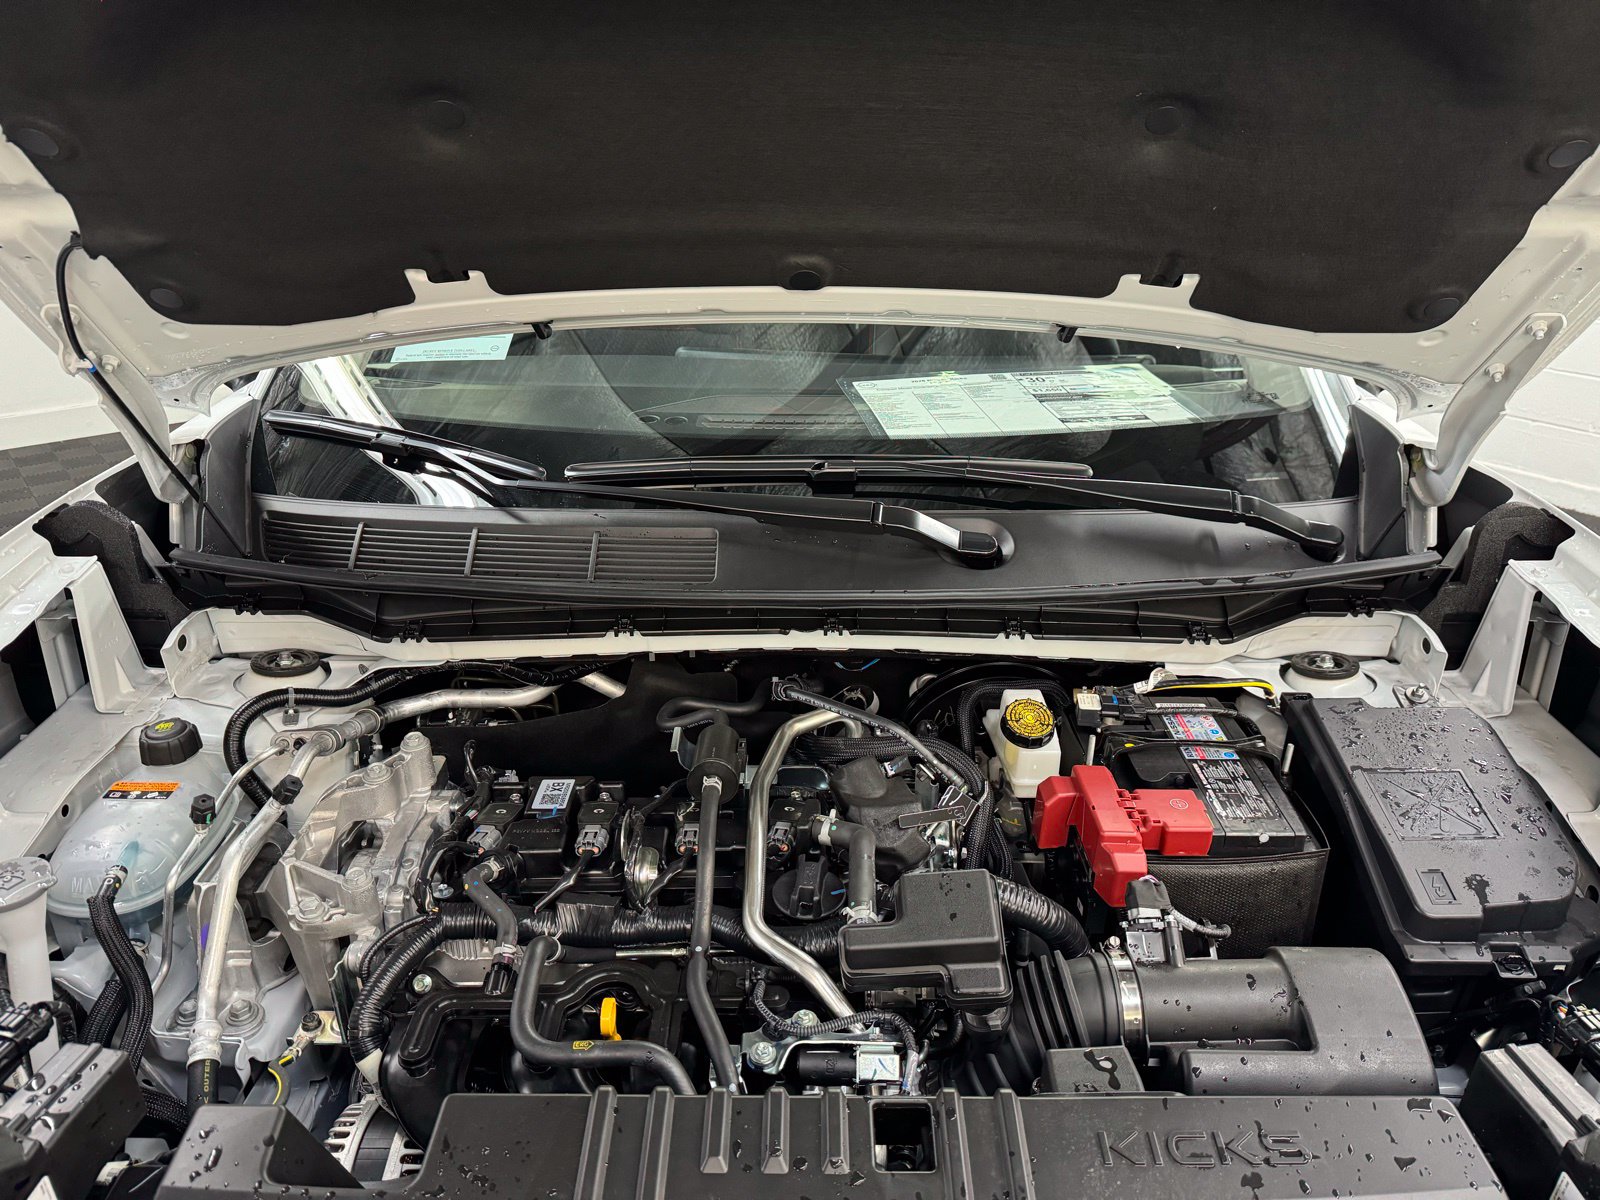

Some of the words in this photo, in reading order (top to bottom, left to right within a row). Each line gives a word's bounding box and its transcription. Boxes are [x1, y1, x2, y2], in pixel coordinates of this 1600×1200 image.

[550, 782, 565, 793] BX
[203, 1059, 212, 1092] OUTER
[1099, 1131, 1314, 1166] KICKS
